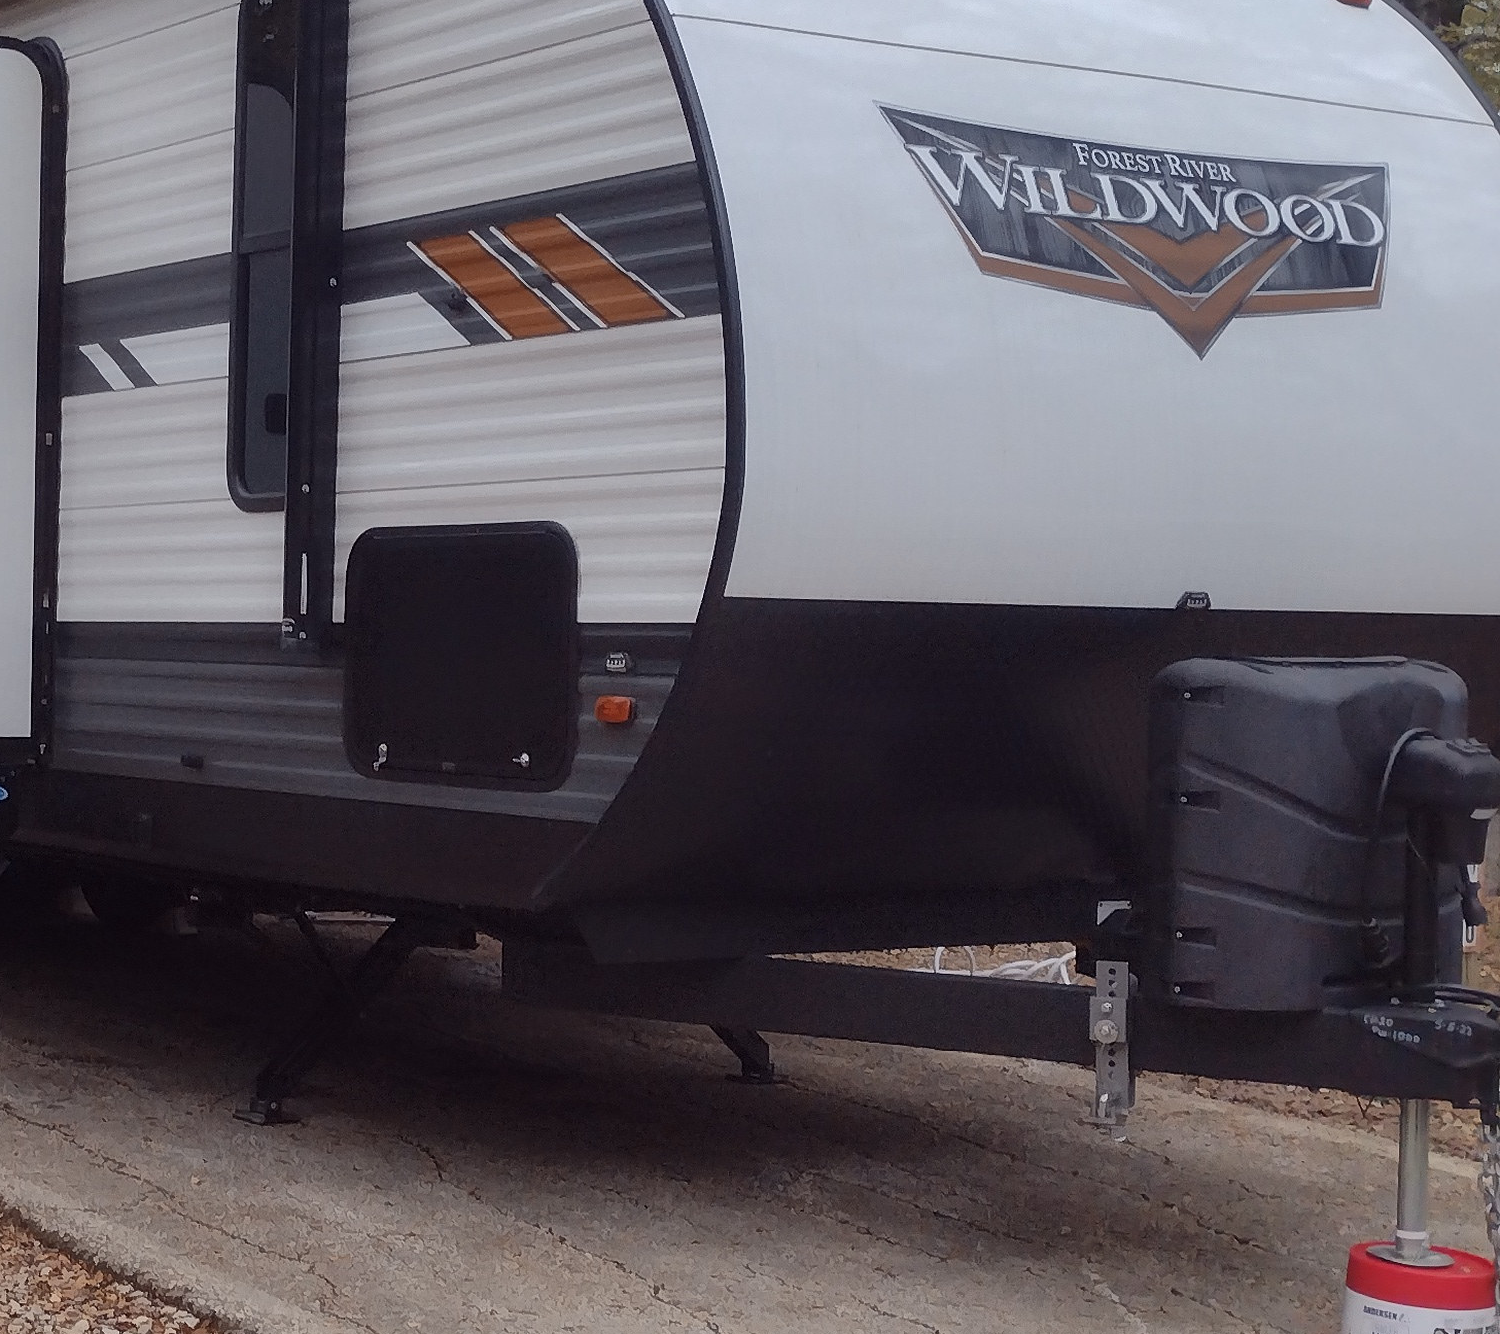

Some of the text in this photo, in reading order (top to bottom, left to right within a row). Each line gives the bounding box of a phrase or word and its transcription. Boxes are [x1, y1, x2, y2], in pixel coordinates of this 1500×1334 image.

[1072, 142, 1238, 183] FOREST RIVER
[903, 142, 1385, 248] WILDWOOD
[1363, 1305, 1398, 1321] ANDERSEN
